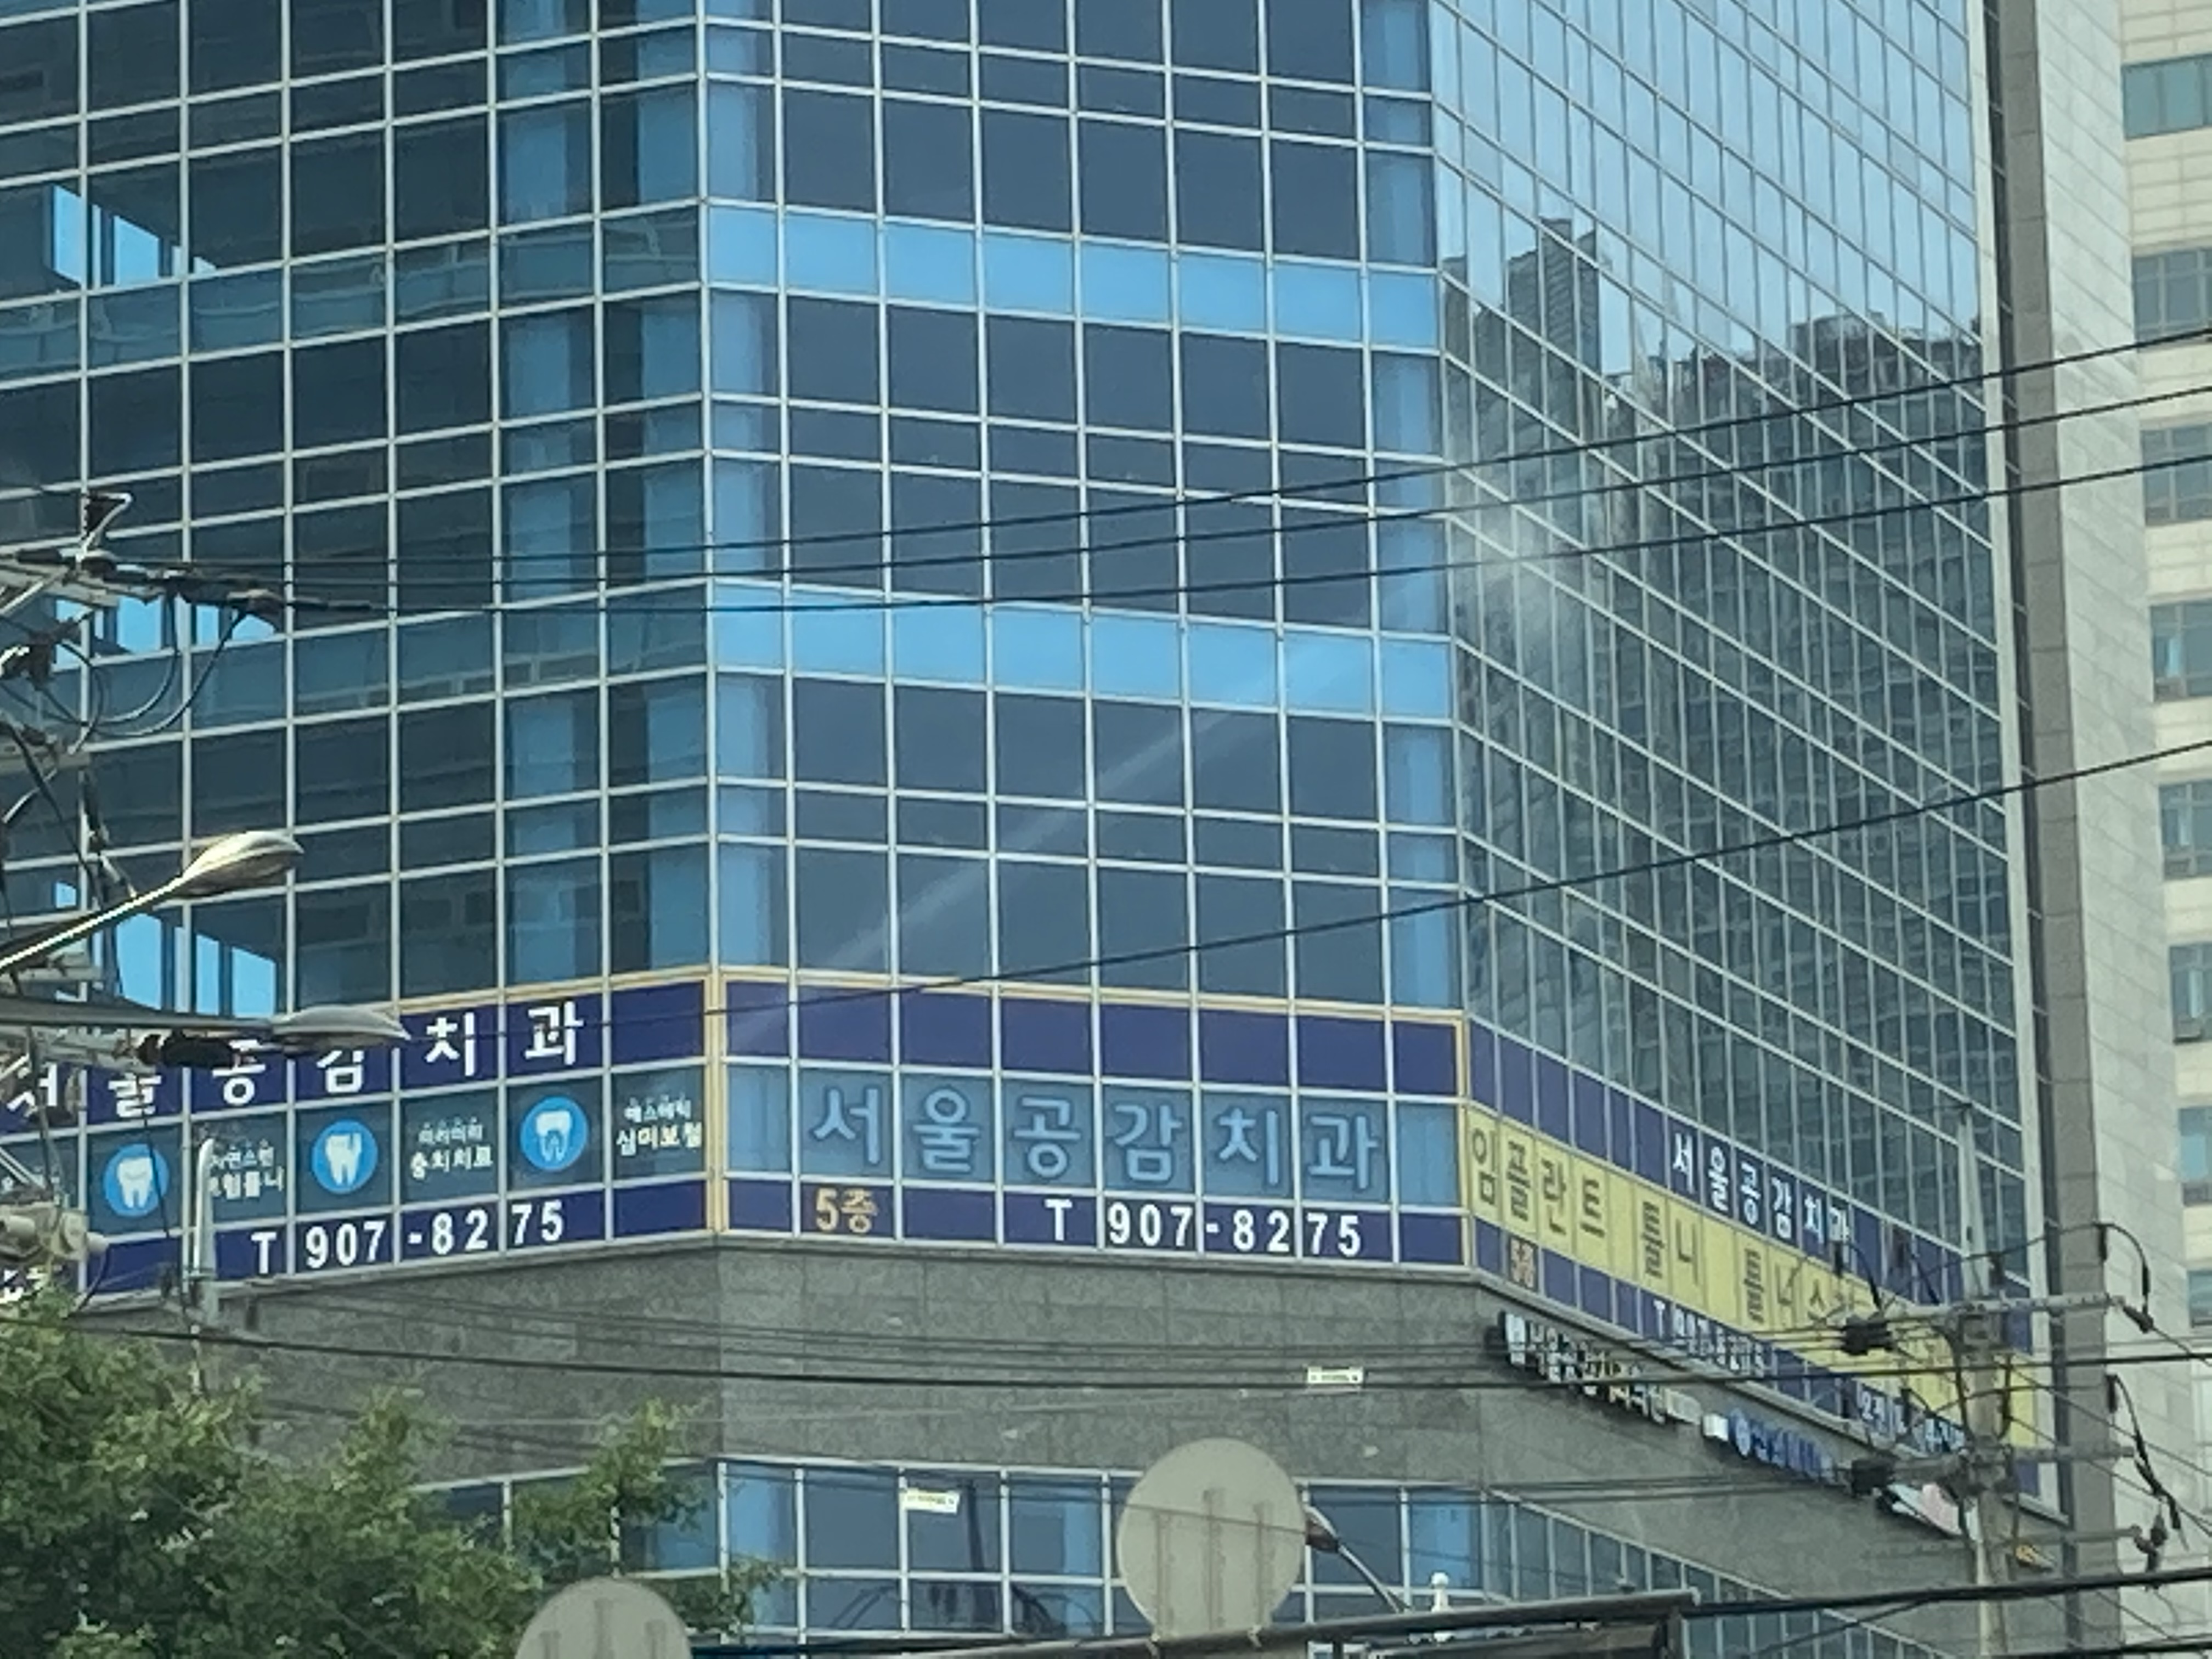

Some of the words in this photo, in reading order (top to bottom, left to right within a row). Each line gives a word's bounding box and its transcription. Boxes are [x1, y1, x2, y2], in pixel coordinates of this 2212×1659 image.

[814, 1087, 1379, 1189] 서울공감치과
[251, 1232, 276, 1274] T
[306, 1201, 562, 1269] 907-8275
[816, 1188, 877, 1233] 5층
[1045, 1199, 1072, 1241] T
[1108, 1202, 1361, 1256] 907-8275
[1472, 1127, 1605, 1238] 임플란트
[1641, 1200, 1699, 1286] 틀니
